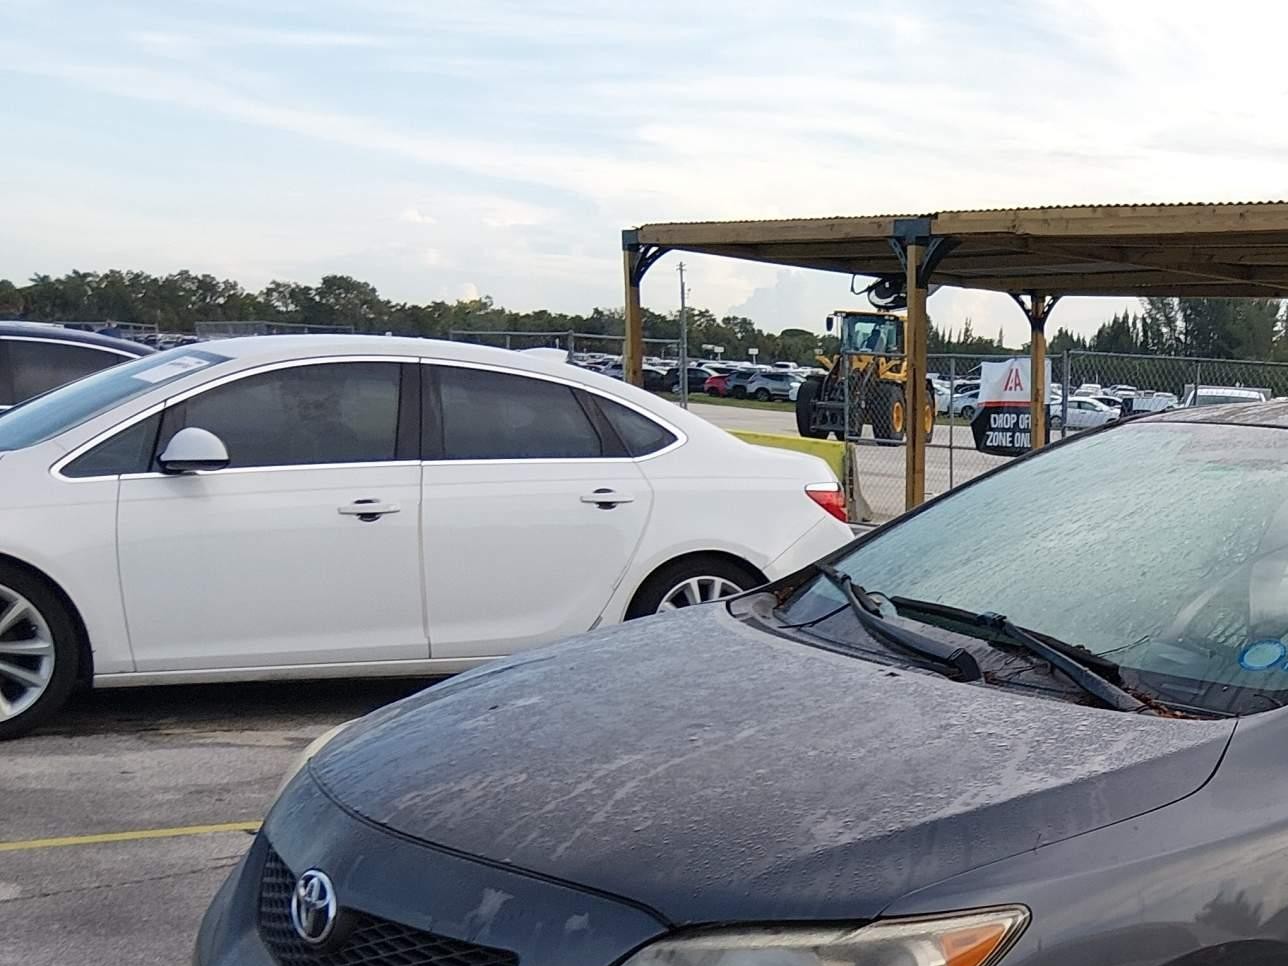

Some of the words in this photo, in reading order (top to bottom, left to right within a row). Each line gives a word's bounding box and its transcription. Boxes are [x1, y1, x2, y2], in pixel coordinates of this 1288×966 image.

[990, 413, 1017, 429] DROP
[985, 431, 1013, 447] ZONE
[1014, 432, 1032, 448] ONL
